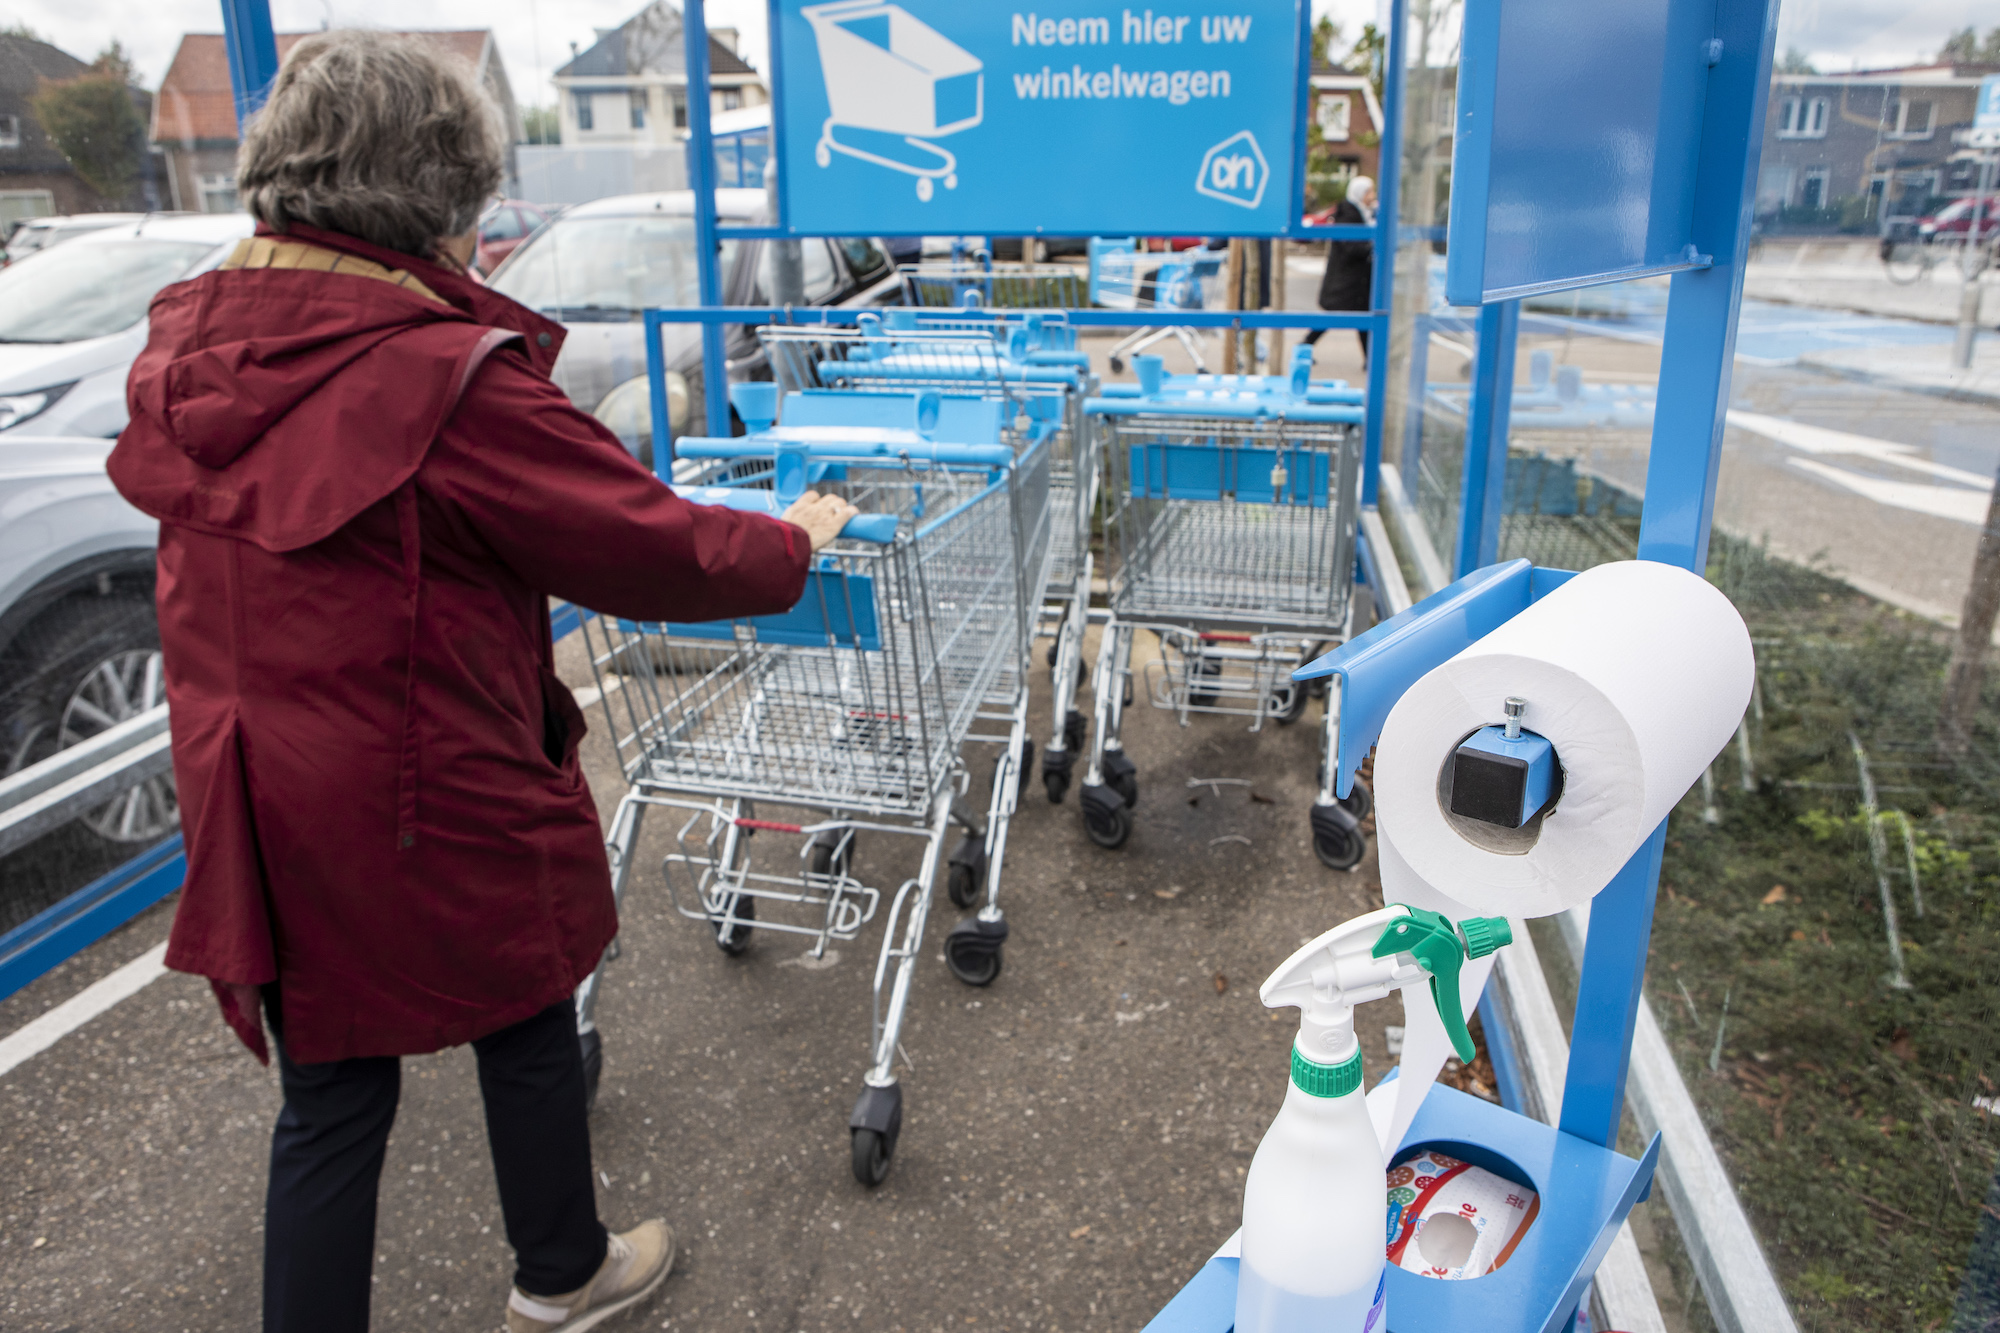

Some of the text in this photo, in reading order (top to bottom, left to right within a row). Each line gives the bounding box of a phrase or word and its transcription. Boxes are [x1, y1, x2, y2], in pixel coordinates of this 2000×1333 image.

[1012, 8, 1252, 46] Neem hier uw
[1013, 63, 1232, 106] winkelwagen
